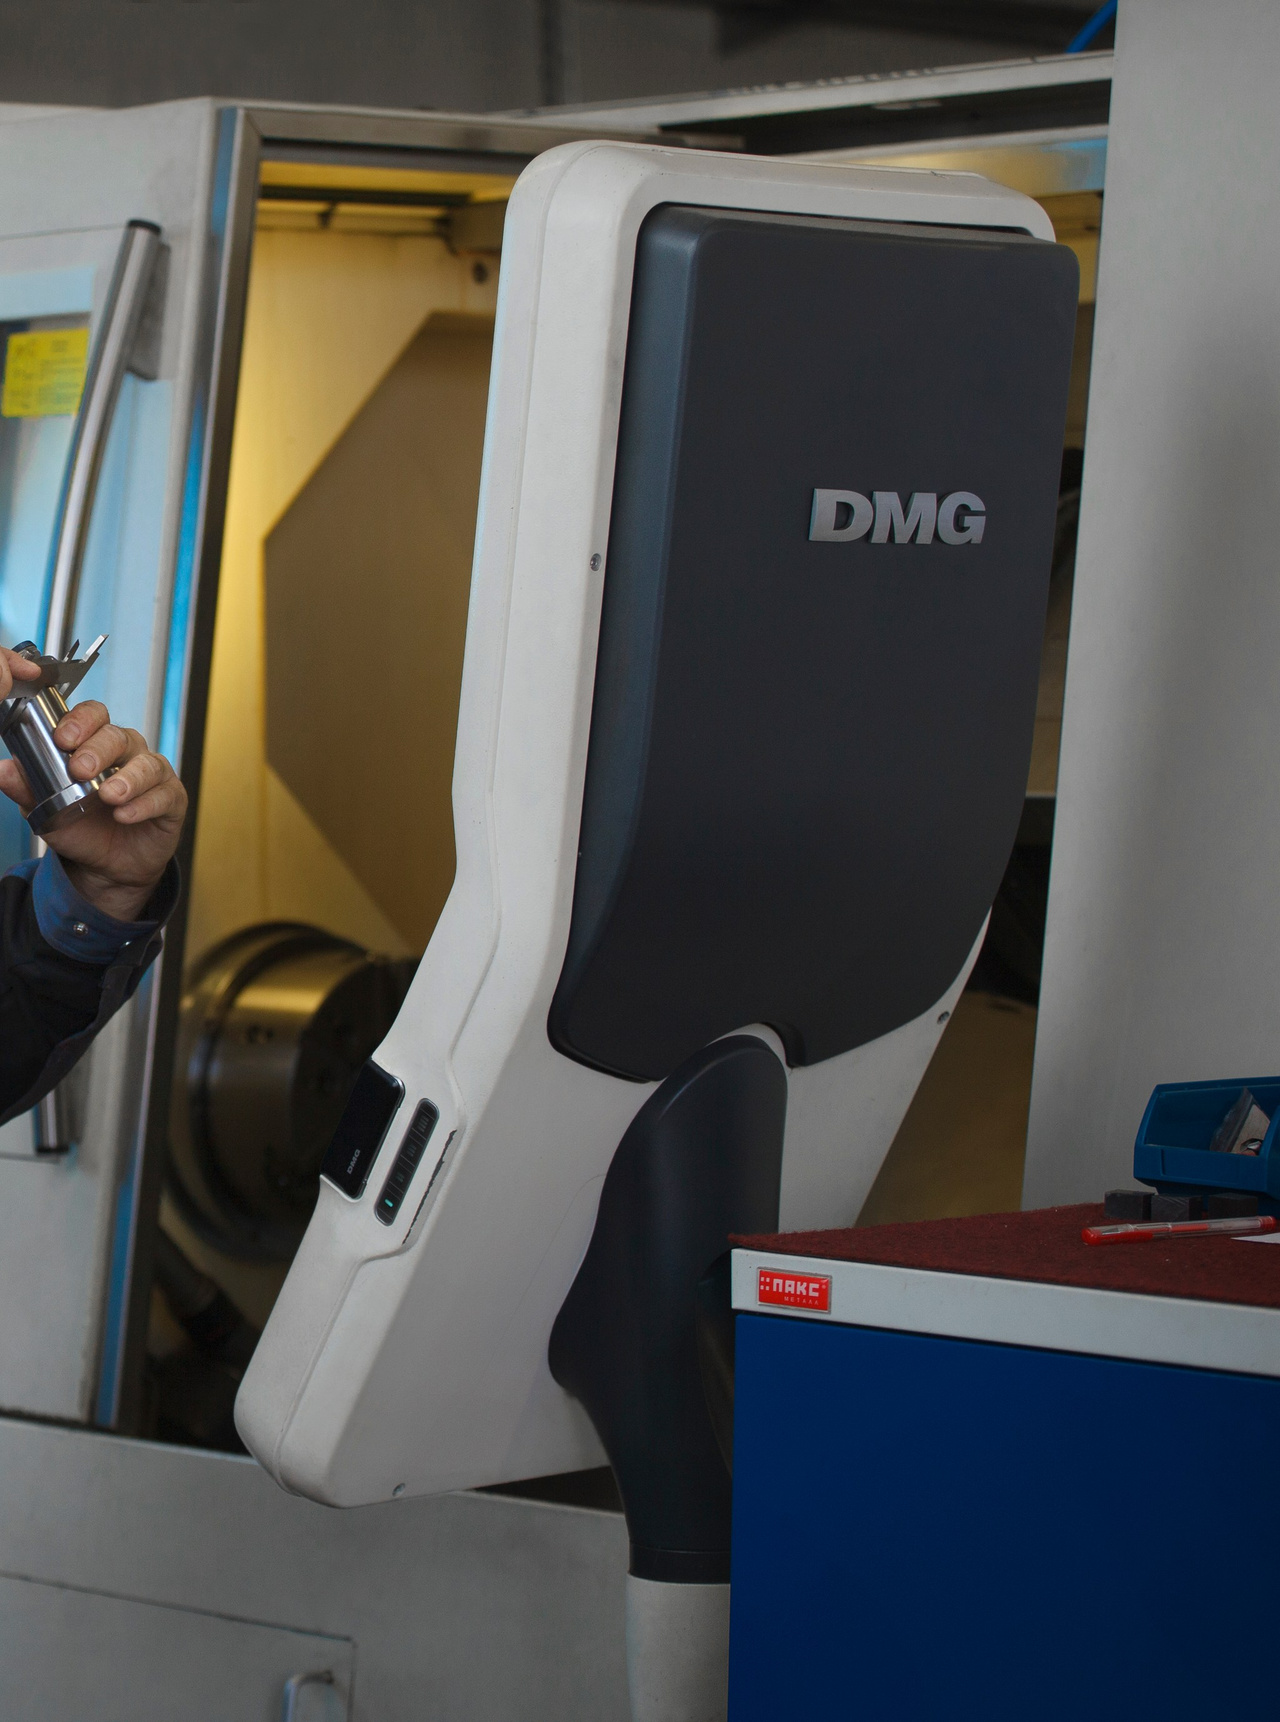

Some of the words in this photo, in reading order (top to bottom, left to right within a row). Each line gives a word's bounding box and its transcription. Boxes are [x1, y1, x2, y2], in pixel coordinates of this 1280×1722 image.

[809, 488, 986, 545] DMG
[347, 1149, 360, 1175] DMG
[773, 1278, 819, 1297] ПАКС
